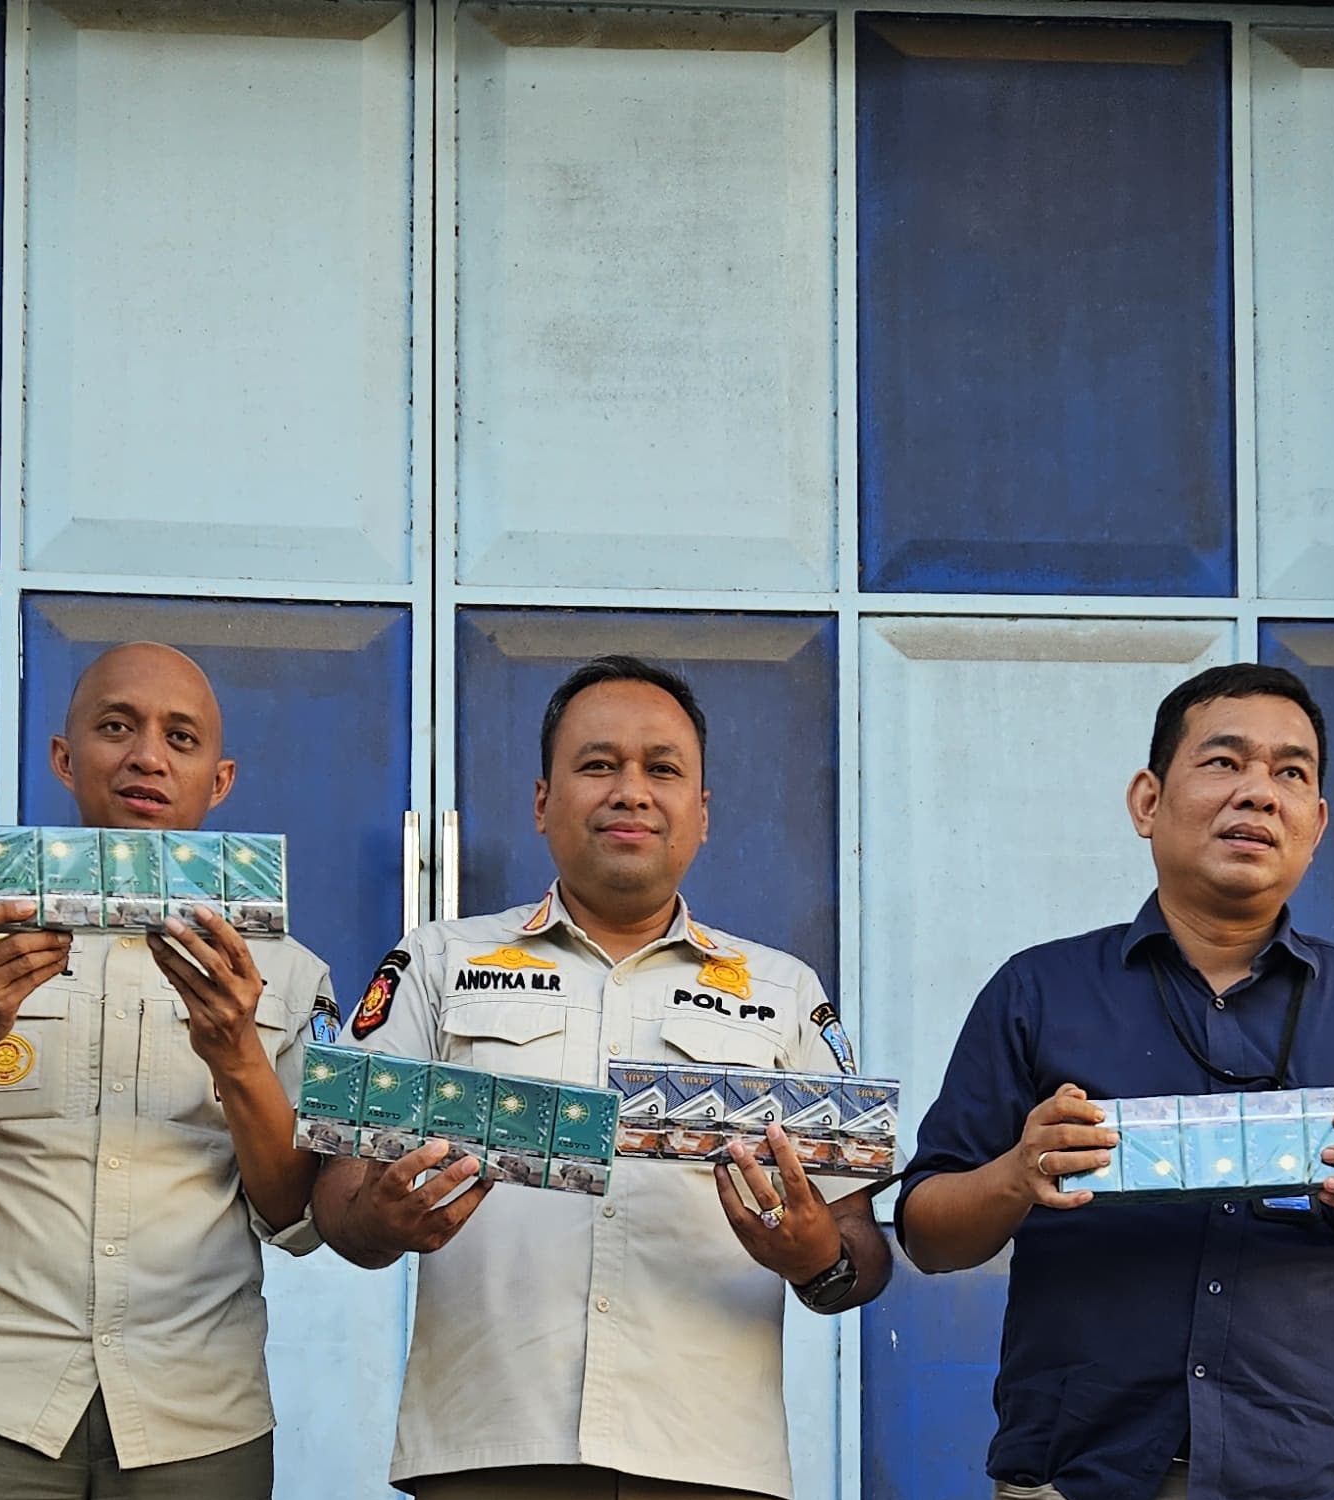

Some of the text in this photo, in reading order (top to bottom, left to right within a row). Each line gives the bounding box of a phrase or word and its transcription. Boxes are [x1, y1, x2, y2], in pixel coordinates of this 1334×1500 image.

[455, 969, 561, 991] ANDYKA M.R
[673, 989, 776, 1021] POL PP
